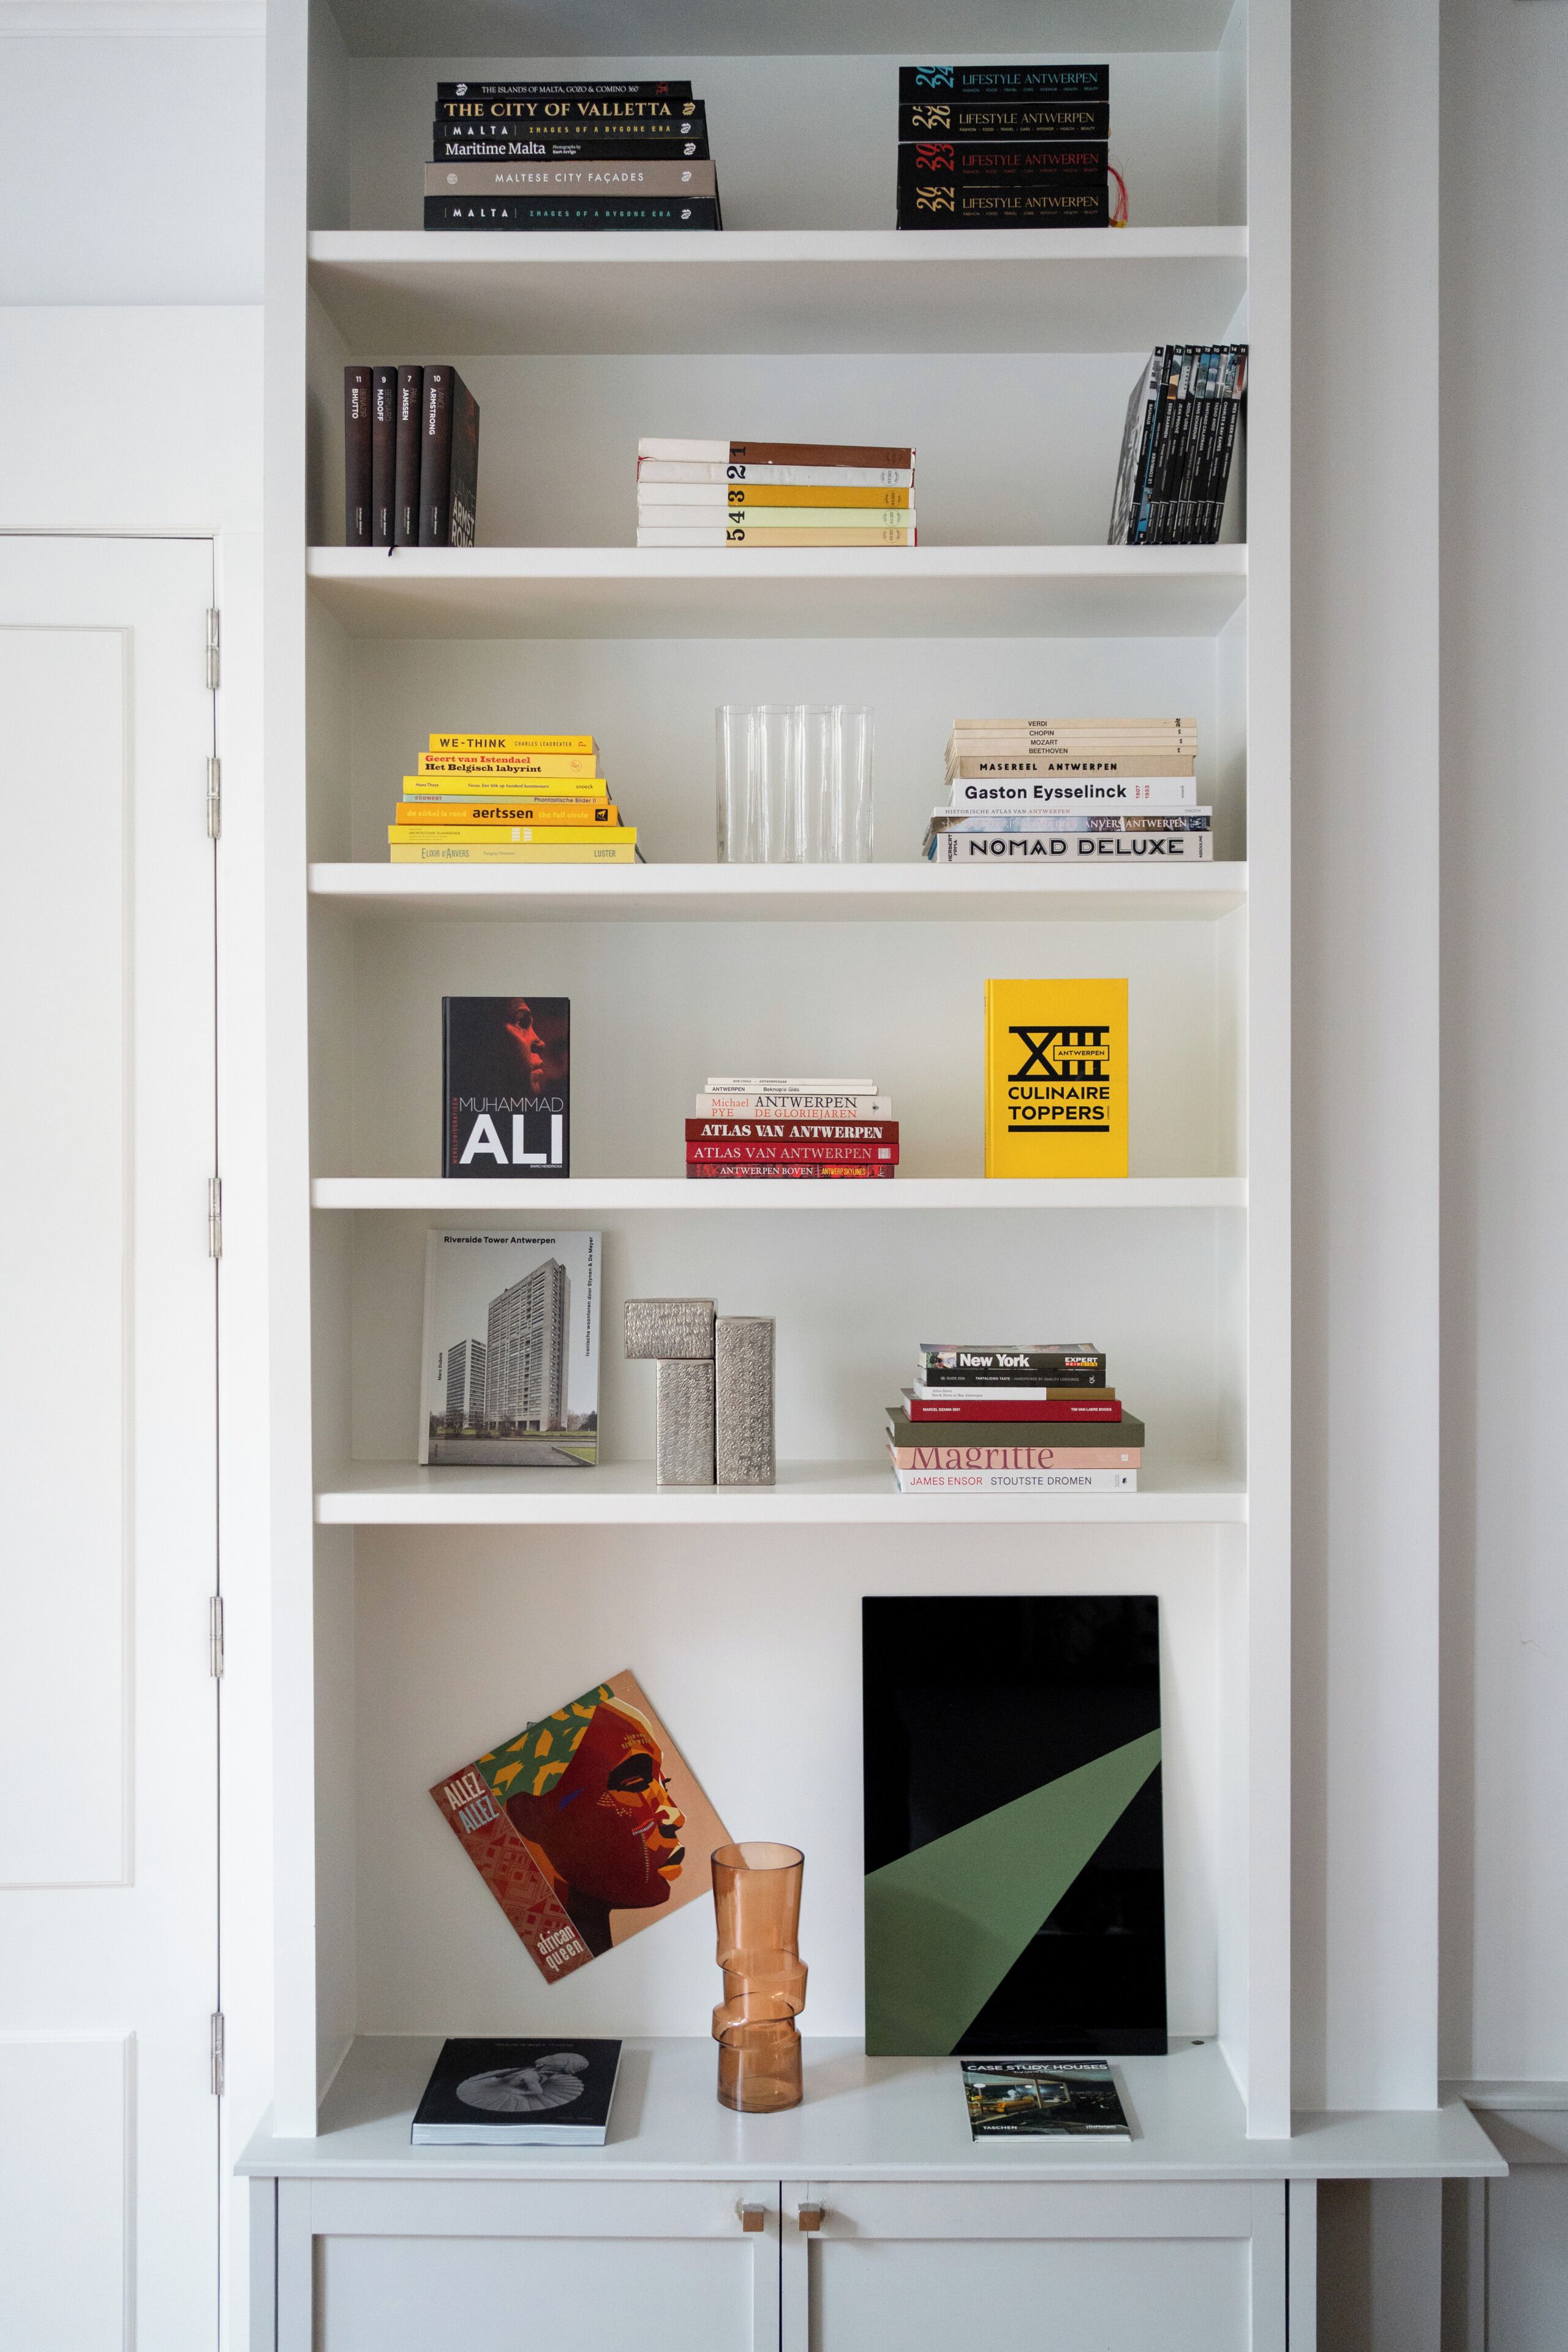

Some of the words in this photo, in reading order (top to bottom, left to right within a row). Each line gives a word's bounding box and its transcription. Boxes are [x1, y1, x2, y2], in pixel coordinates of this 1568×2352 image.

[963, 74, 1021, 85] LIFESTYLE
[1025, 72, 1098, 84] ANTWERPEN
[444, 103, 484, 116] THE
[491, 103, 538, 116] CITY
[545, 103, 570, 116] OF
[577, 102, 672, 116] VALLETTA
[959, 114, 1018, 124] LIFESTYLE
[1022, 113, 1095, 124] ANTWERPEN
[453, 126, 508, 135] MALTA
[446, 143, 506, 156] Maritime
[508, 142, 546, 154] Malta
[962, 156, 1021, 167] LIFESTYLE
[1025, 154, 1099, 165] ANTWERPEN
[555, 173, 582, 182] CITY
[588, 173, 644, 184] FAÇADES
[963, 198, 1022, 209] LIFESTYLE
[1025, 197, 1099, 207] ANTWERPEN
[453, 208, 508, 217] MALTA
[731, 446, 746, 456] 1
[726, 464, 746, 480] 2
[728, 490, 745, 502] 3
[728, 511, 745, 523] 4
[726, 528, 745, 541] 5
[440, 739, 506, 747] WE-THINK
[448, 764, 494, 773] Belgisch
[965, 786, 1027, 799] Gaston
[1034, 785, 1127, 801] Eysselinck
[473, 808, 533, 818] aertssen
[421, 848, 440, 858] ELIXIR
[970, 838, 1068, 856] NOMAD
[1077, 838, 1184, 856] DELUXE
[1008, 1087, 1110, 1099] CULINAIRE
[459, 1098, 564, 1112] MUHAMMAD
[711, 1098, 749, 1107] Michael
[755, 1096, 858, 1108] ANTWERPEN
[755, 1109, 771, 1117] DE
[774, 1109, 856, 1120] GLORIEJAREN
[1008, 1106, 1104, 1120] TOPPERS
[701, 1125, 751, 1137] ATLAS
[755, 1125, 784, 1137] VAN
[789, 1126, 883, 1139] ANTWERPEN
[459, 1114, 562, 1164] ALI
[693, 1148, 741, 1158] ATLAS
[745, 1148, 777, 1158] VAN
[780, 1148, 872, 1159] ANTWERPEN
[960, 1354, 992, 1367] New
[996, 1354, 1030, 1367] York
[911, 1447, 1054, 1469] Magritte
[443, 1771, 486, 1811] ALLEZ
[458, 1795, 500, 1834] ALLEZ
[537, 1926, 576, 1955] african
[545, 1939, 583, 1971] queen
